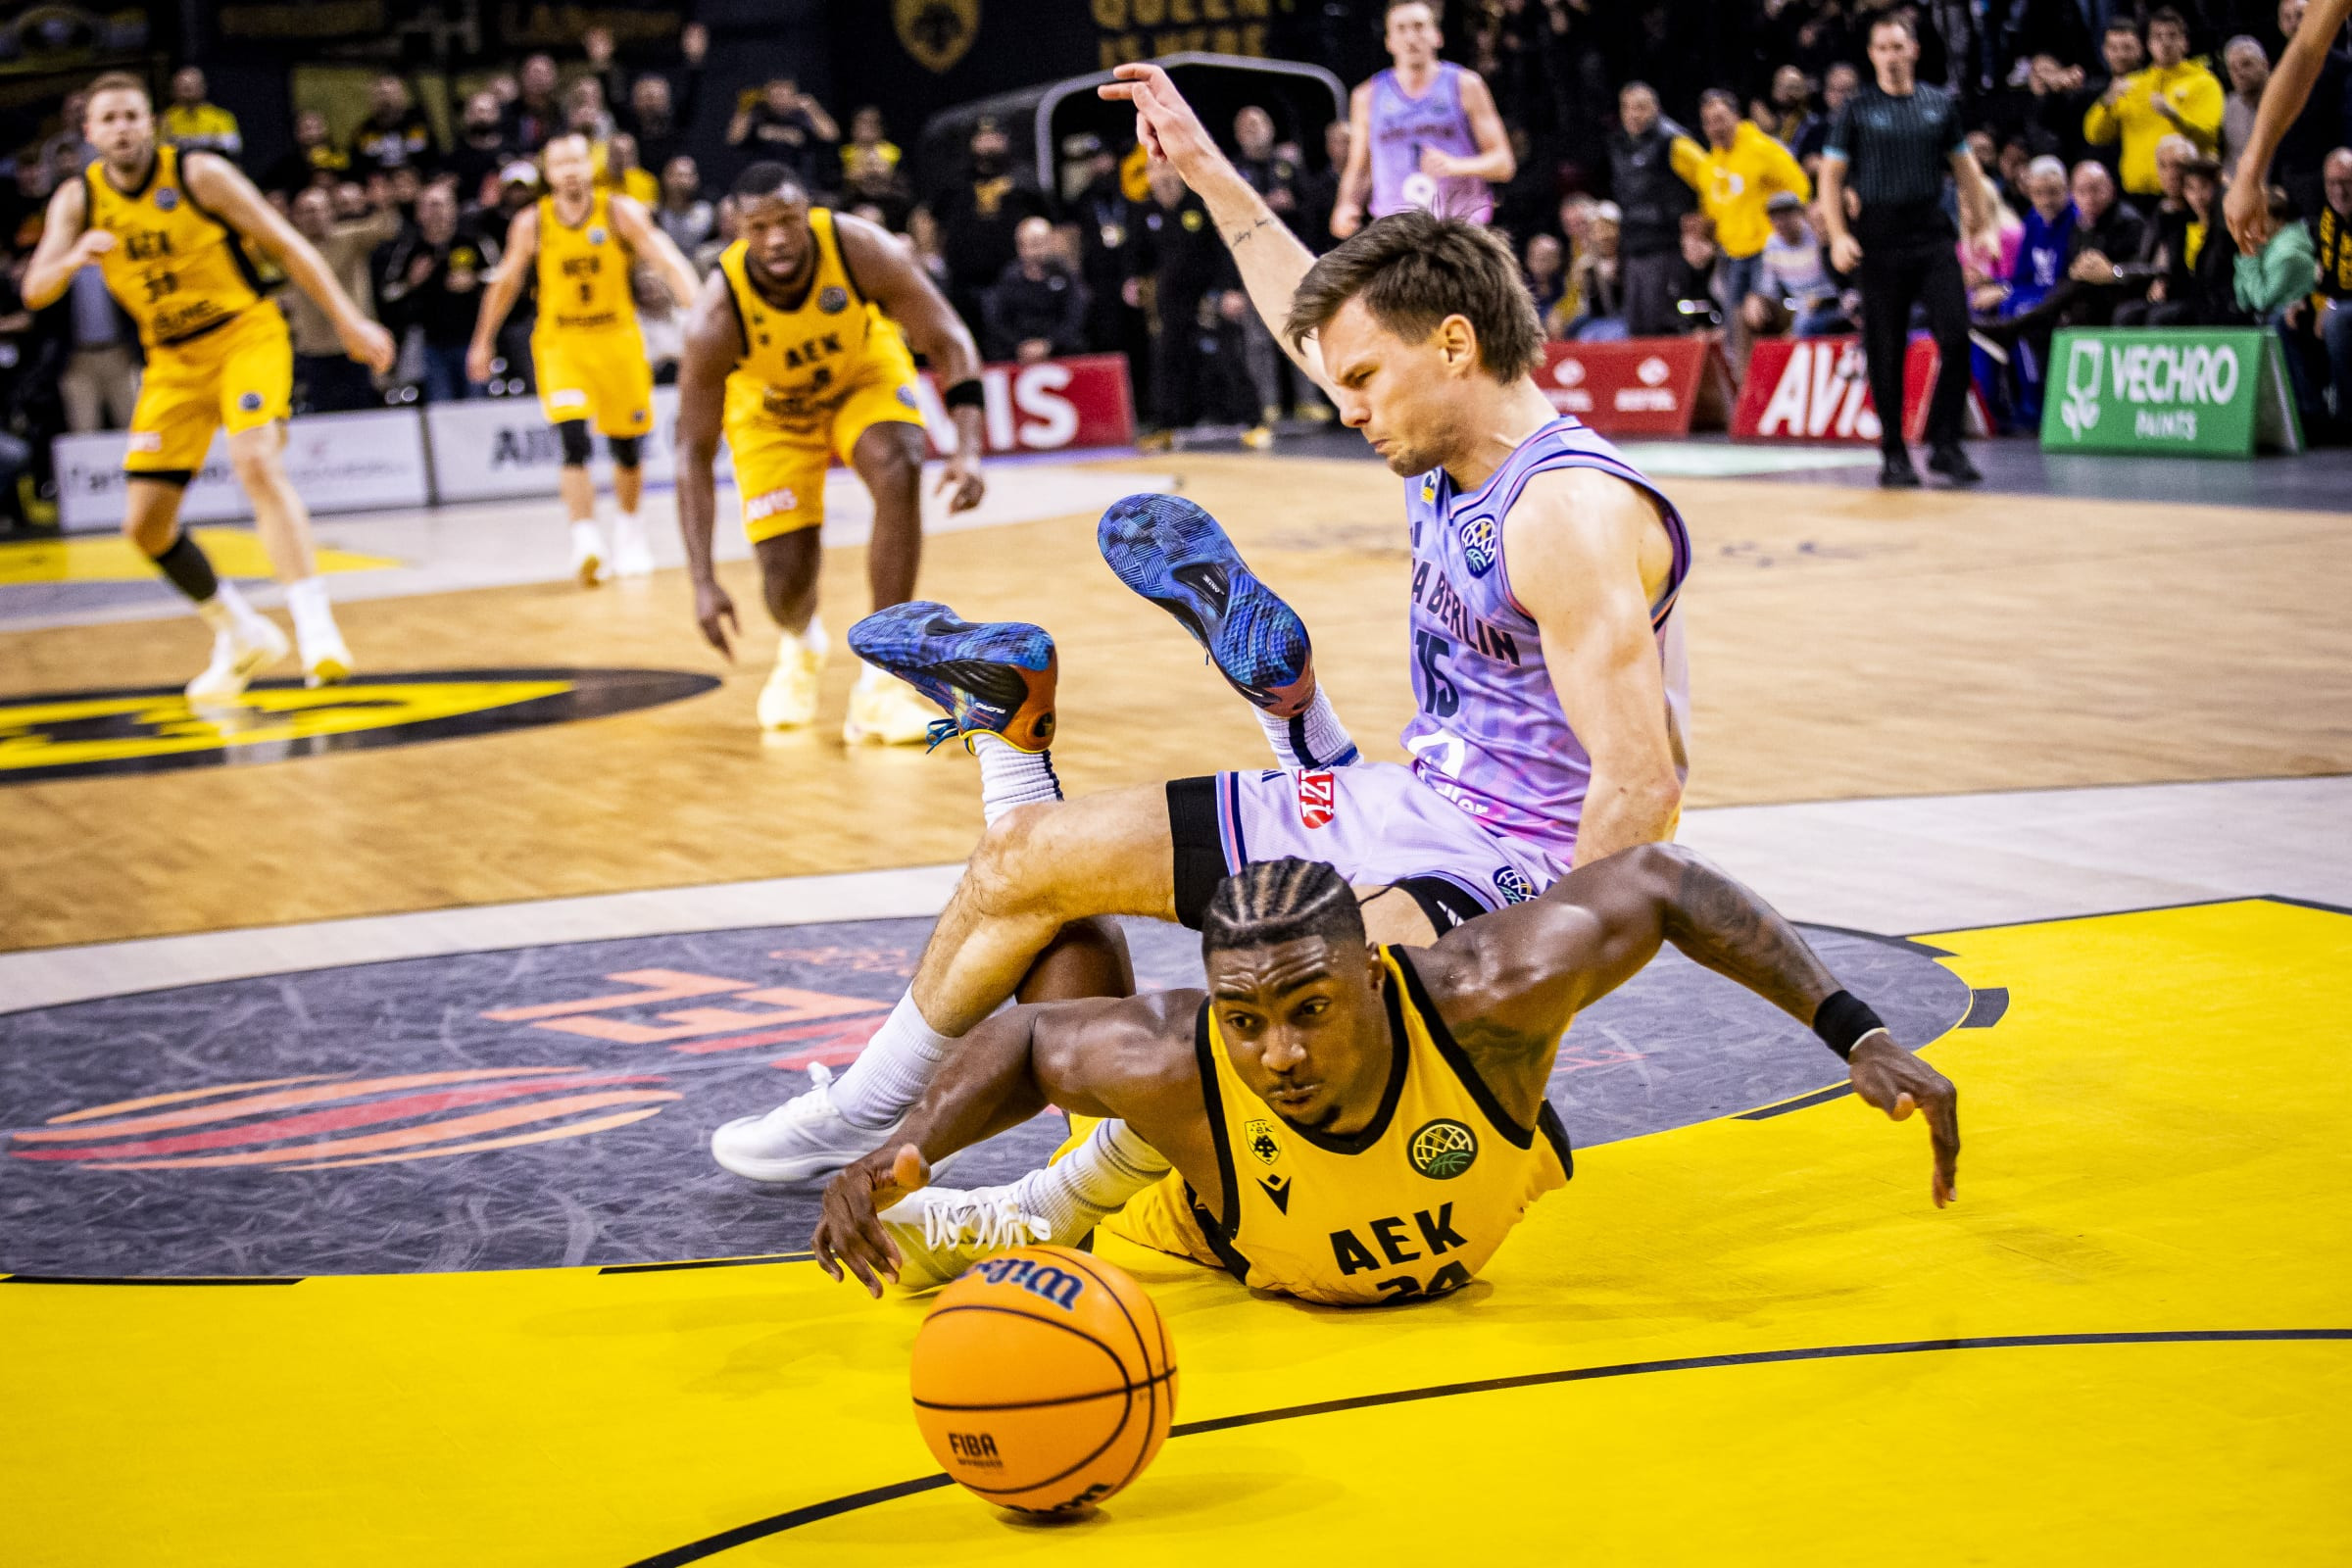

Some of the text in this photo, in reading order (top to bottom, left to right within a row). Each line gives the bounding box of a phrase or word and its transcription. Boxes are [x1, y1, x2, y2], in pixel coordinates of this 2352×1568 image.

[2111, 344, 2239, 405] VECHRO
[2134, 409, 2197, 441] PAINTS
[1427, 570, 1521, 666] BERLIN
[1415, 629, 1459, 718] 15
[1330, 1201, 1468, 1275] AEK
[948, 1433, 999, 1457] FIBA
